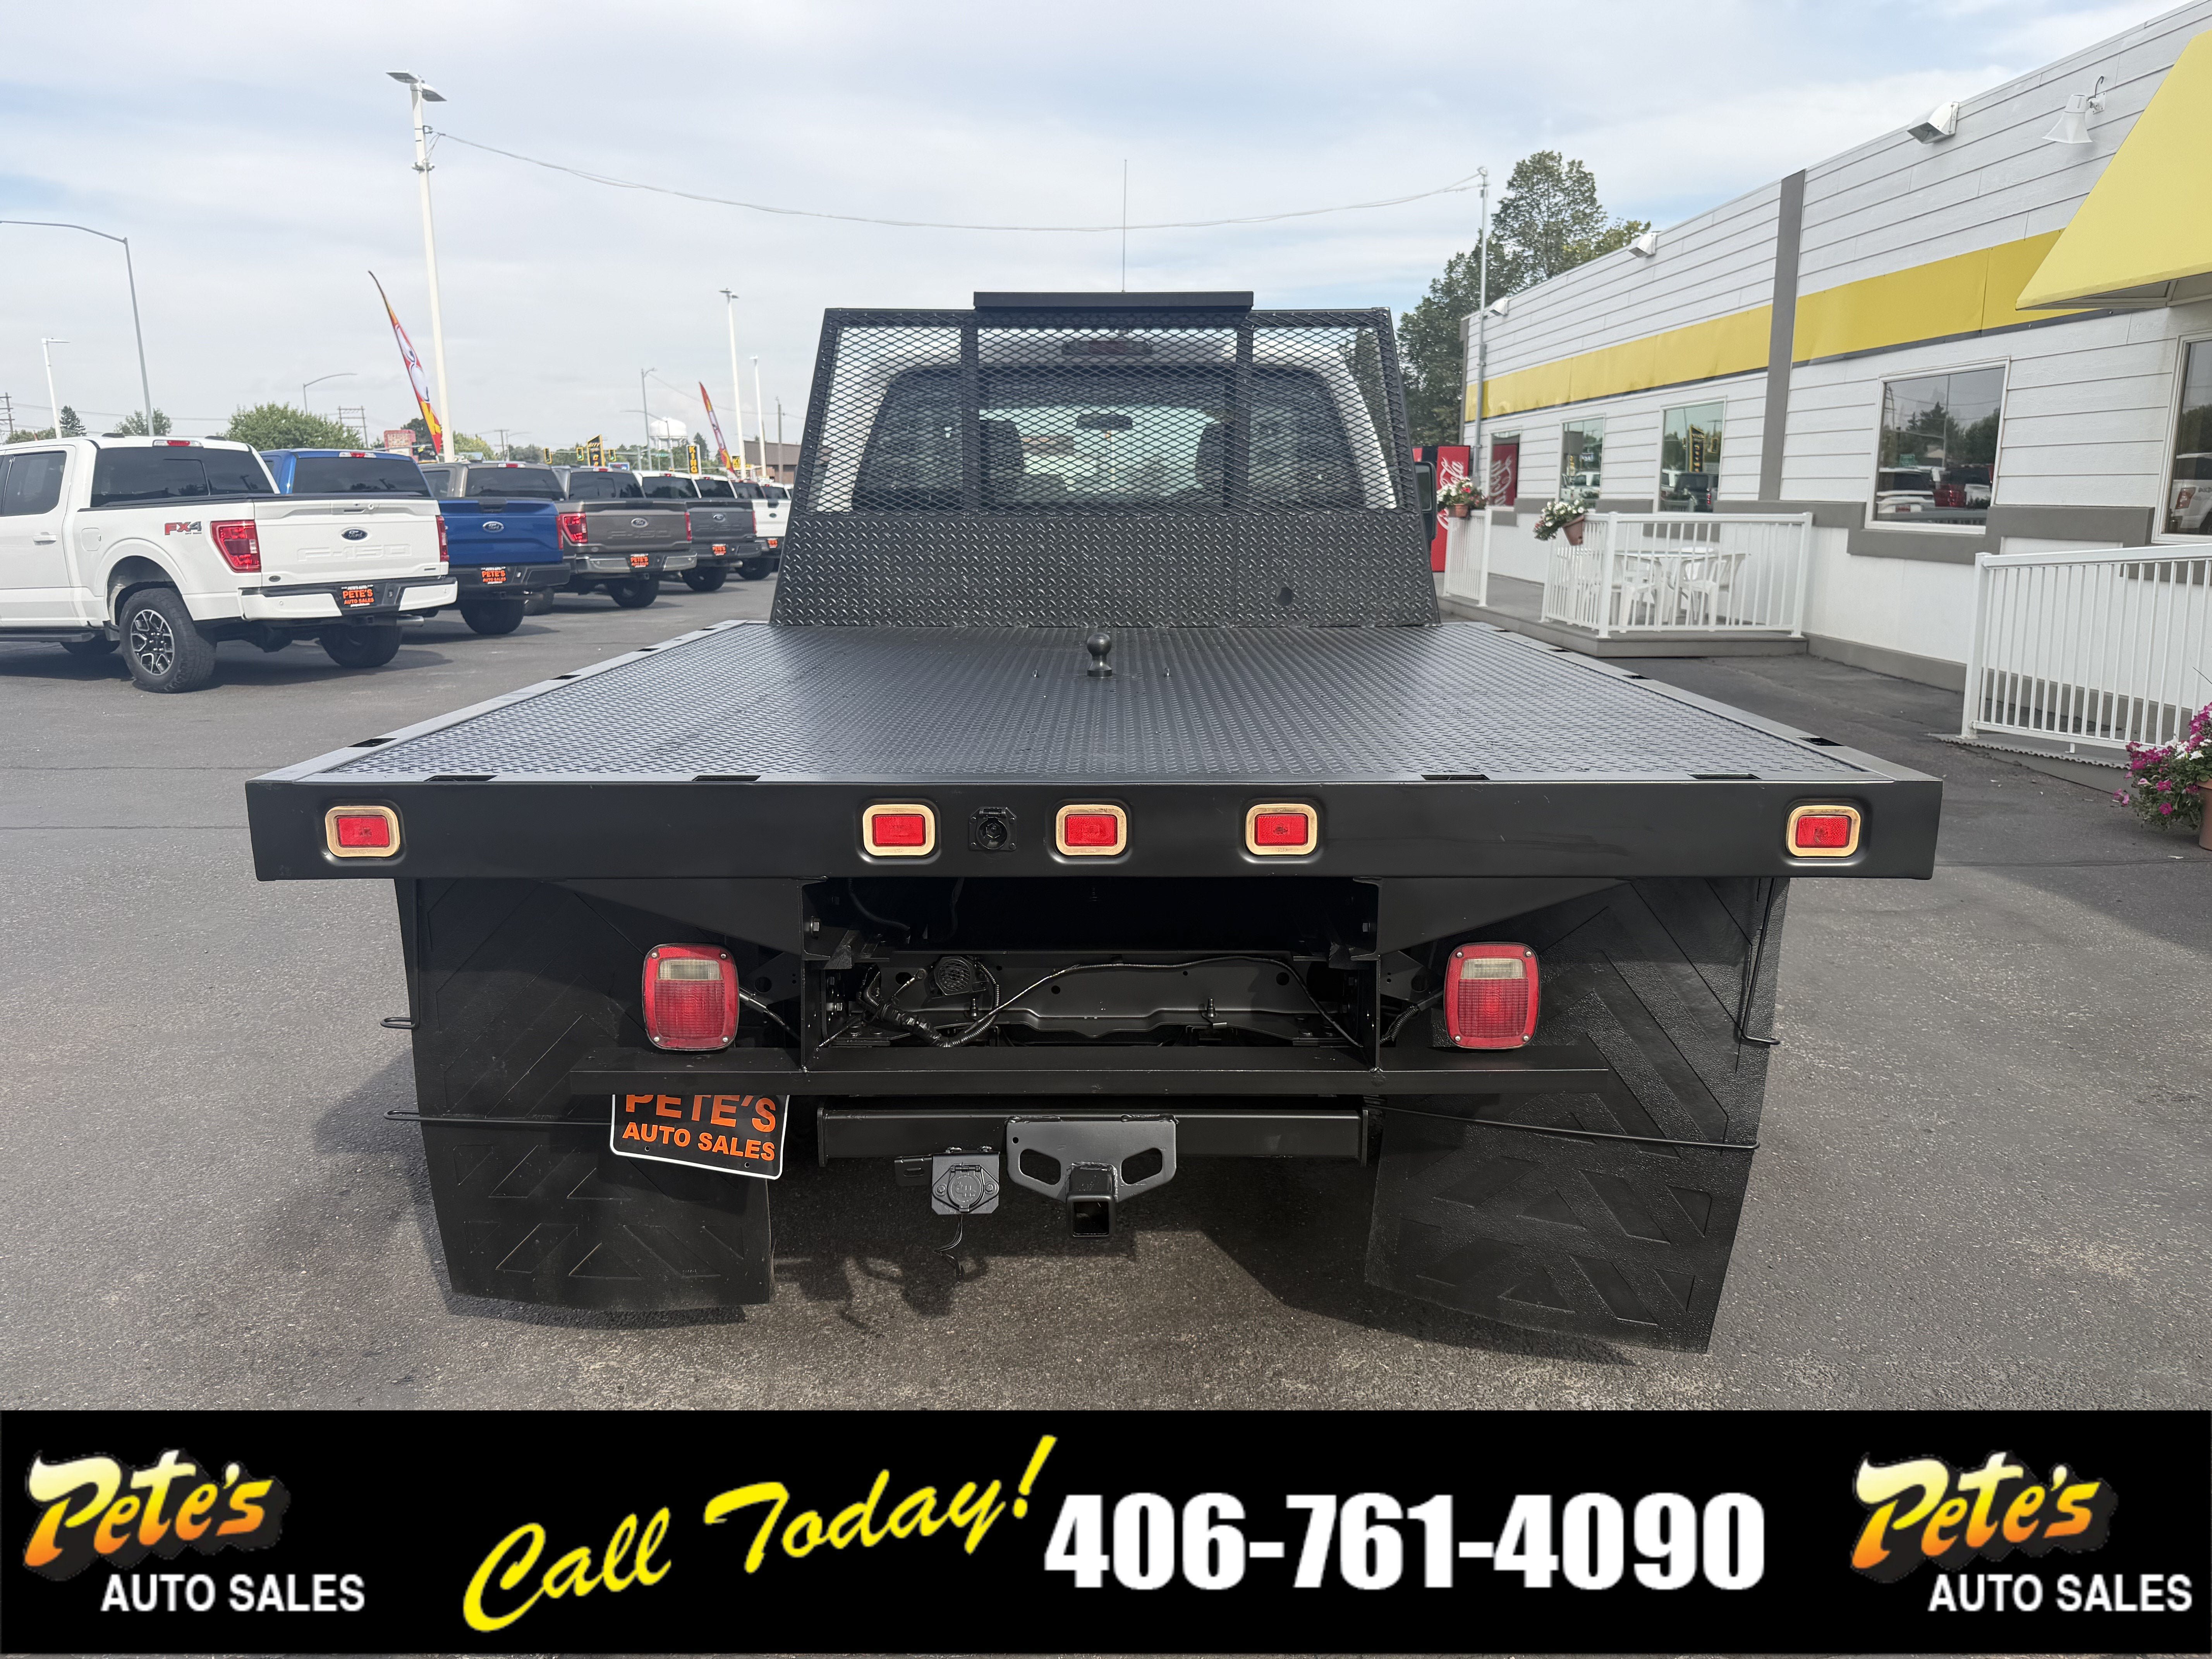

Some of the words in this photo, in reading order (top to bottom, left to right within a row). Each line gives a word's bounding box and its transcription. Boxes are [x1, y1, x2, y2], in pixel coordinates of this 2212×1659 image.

[689, 446, 697, 473] KING
[165, 521, 202, 535] FX4
[297, 544, 412, 562] F-150
[342, 589, 373, 599] PETE'S
[622, 1122, 691, 1147] AUTO
[698, 1132, 775, 1161] SALES
